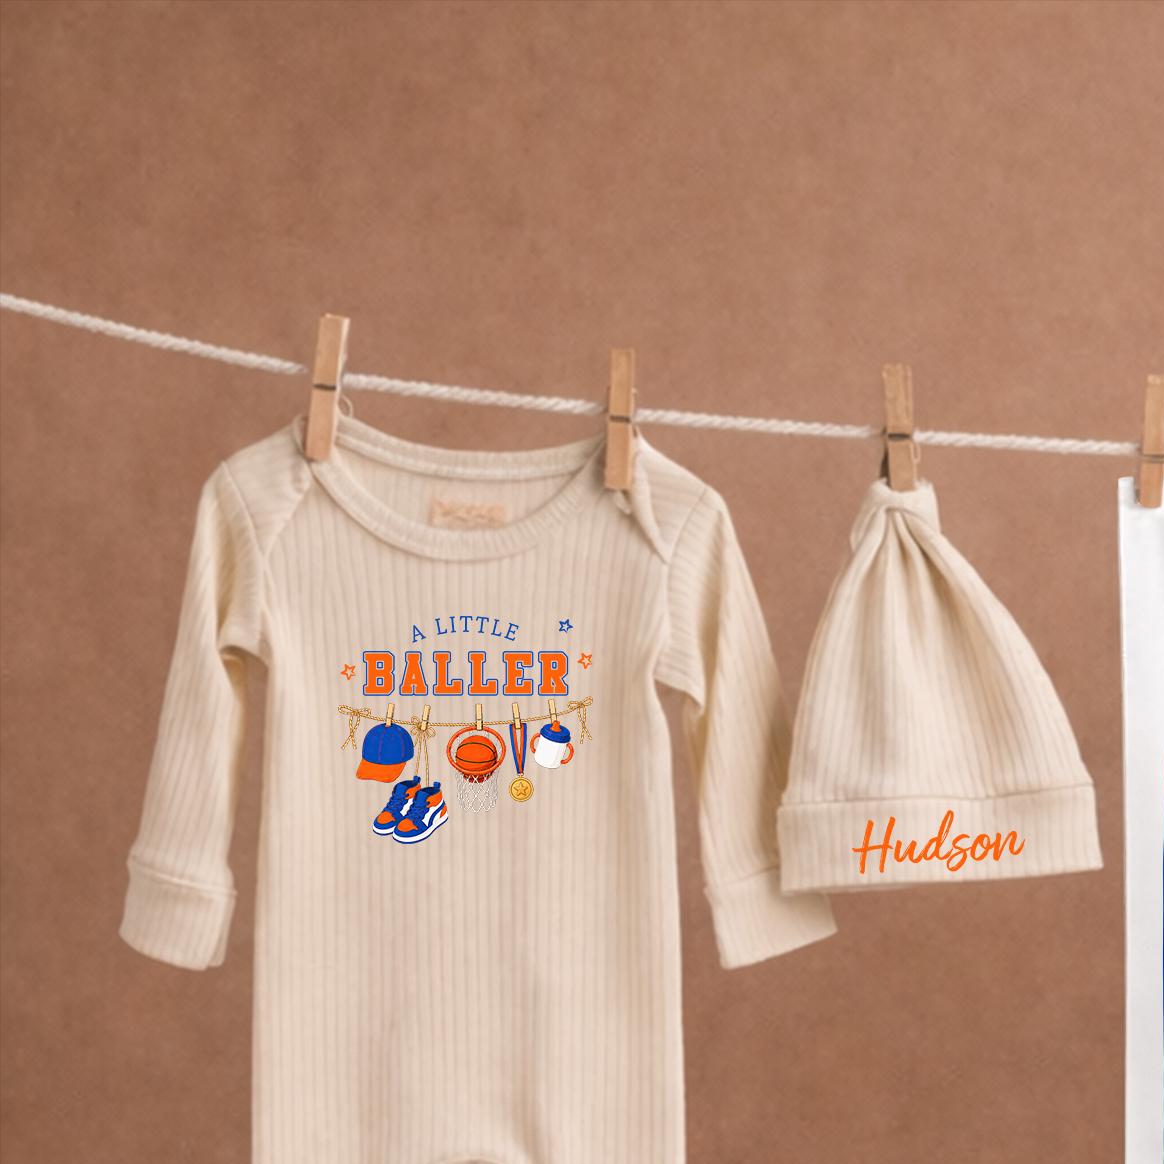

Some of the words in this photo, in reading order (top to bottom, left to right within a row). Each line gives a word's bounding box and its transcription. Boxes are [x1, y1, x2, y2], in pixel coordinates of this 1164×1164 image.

[411, 624, 426, 643] A
[435, 615, 519, 641] LITTLE
[362, 650, 569, 696] BALLER
[852, 810, 1025, 874] Hudson
